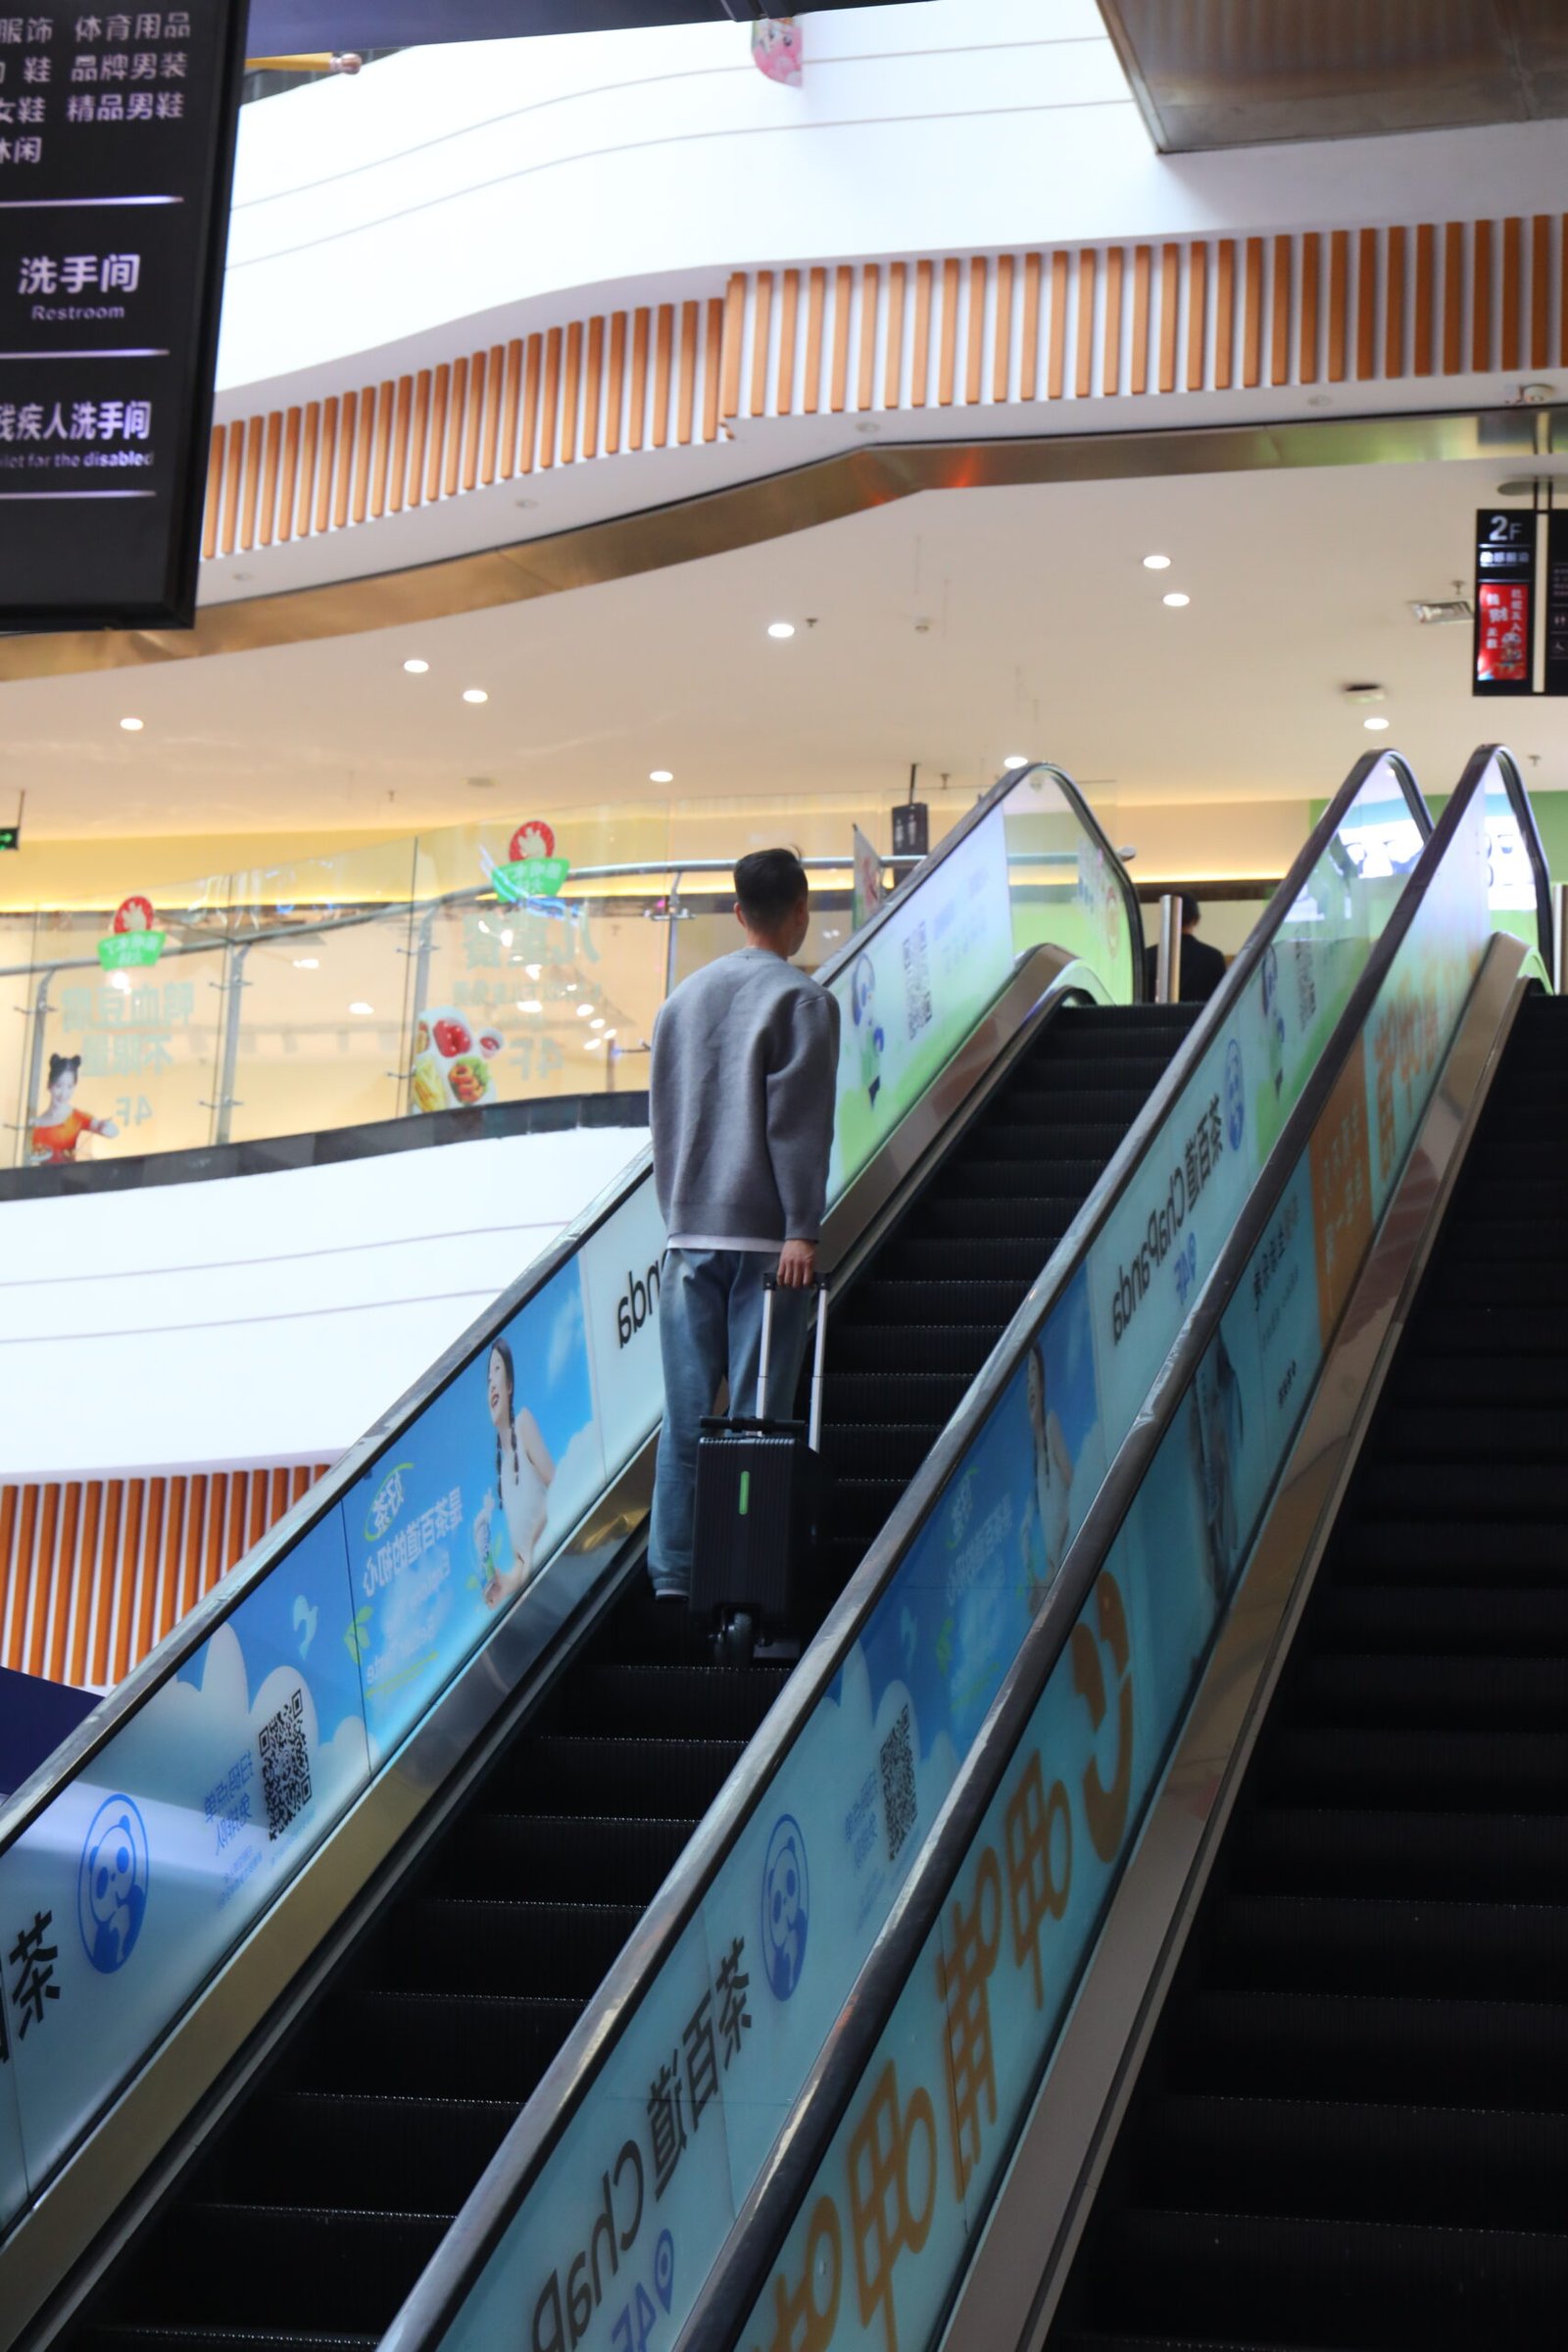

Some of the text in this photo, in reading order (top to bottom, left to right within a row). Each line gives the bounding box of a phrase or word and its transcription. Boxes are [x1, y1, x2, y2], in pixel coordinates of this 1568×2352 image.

[74, 12, 191, 42] 体育用品
[71, 51, 188, 82] 品牌男装
[66, 91, 185, 122] 精品男鞋
[19, 254, 140, 294] 洗手间
[31, 305, 124, 320] Restroom
[54, 452, 80, 467] the
[83, 450, 155, 466] disabled
[1489, 514, 1522, 541] 2F
